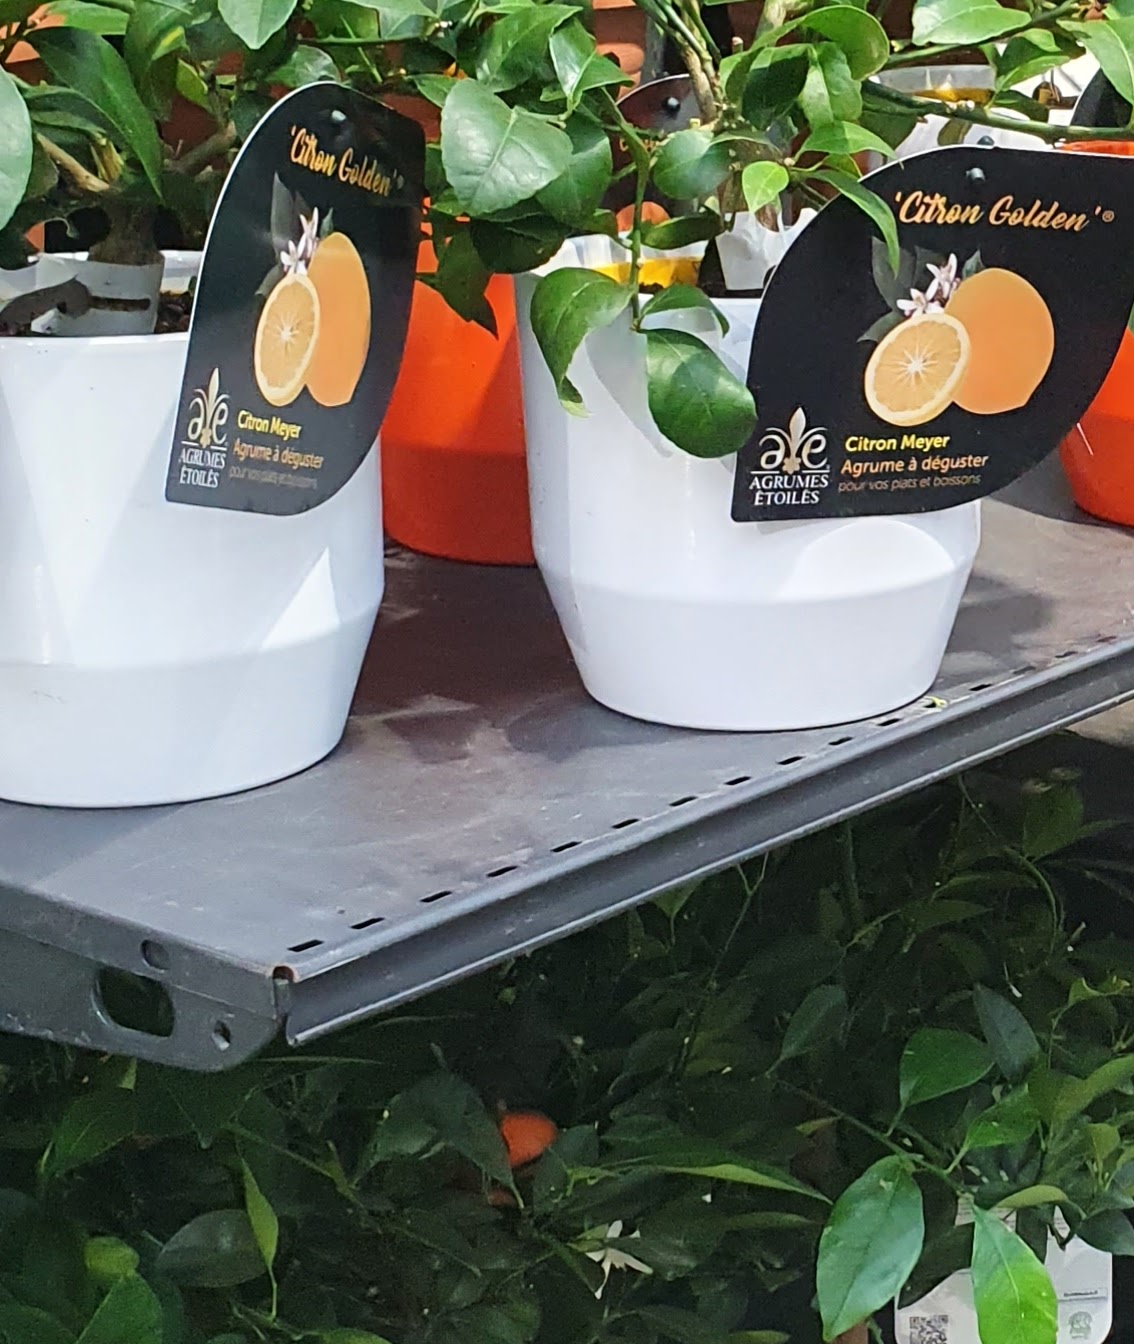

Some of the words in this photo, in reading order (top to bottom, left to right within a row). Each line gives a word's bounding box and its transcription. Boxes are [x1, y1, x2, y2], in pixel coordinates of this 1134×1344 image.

[237, 410, 269, 432] Citron
[269, 416, 302, 441] Meyer
[845, 436, 897, 452] Citron
[900, 434, 950, 452] Meyer
[178, 448, 227, 469] AGRUMES
[233, 438, 271, 461] Agrume
[281, 446, 325, 470] déguster
[840, 459, 904, 478] Agrume
[907, 457, 918, 471] à
[921, 454, 989, 473] déguster
[749, 474, 829, 490] AGRUMES
[838, 480, 865, 493] pour
[868, 479, 889, 491] vos
[933, 473, 981, 487] boissons
